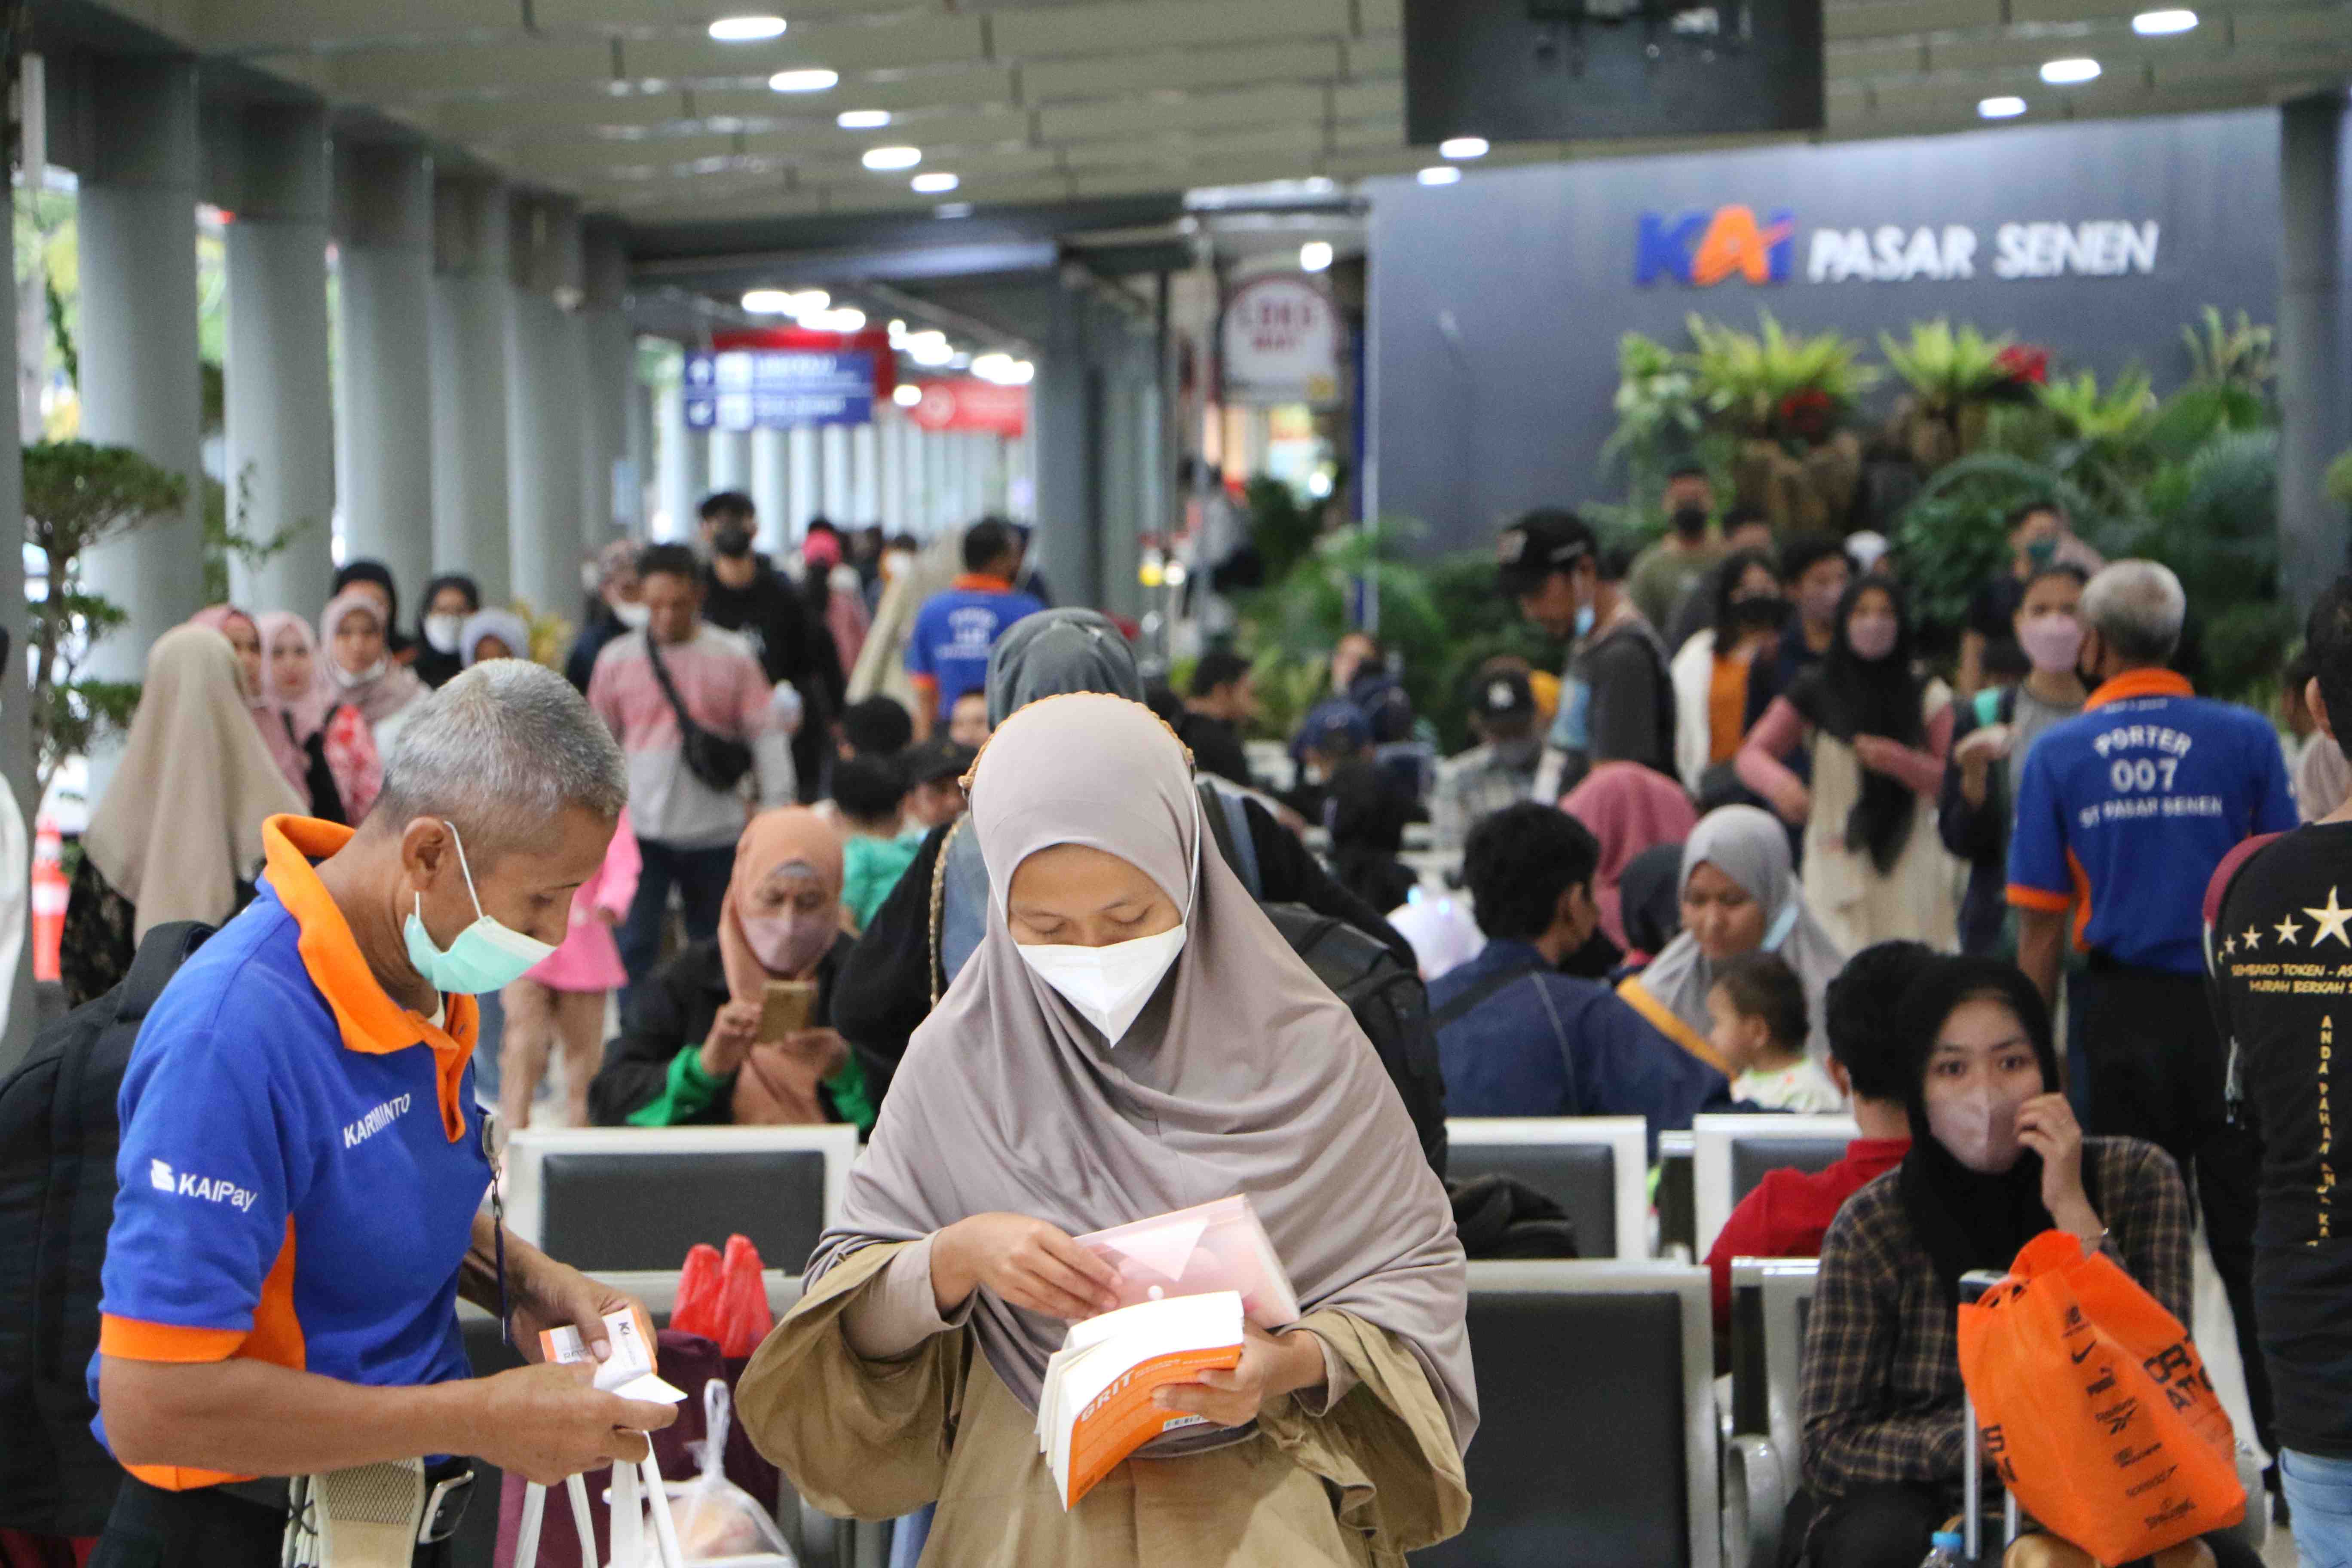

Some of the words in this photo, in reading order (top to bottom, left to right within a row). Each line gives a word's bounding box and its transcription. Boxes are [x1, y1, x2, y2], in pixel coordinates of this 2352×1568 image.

[1635, 205, 1793, 285] KAI
[1808, 226, 1976, 282] PASAR
[1994, 220, 2160, 279] SENEN
[2093, 724, 2192, 758] PORTER
[2110, 757, 2178, 792] 007
[2102, 797, 2159, 822] PASAR
[2161, 794, 2223, 818] SENEN
[2231, 964, 2280, 977] SEMBAKO
[2282, 963, 2326, 976] TOKEN
[2249, 980, 2290, 992] MURAH
[2293, 980, 2346, 994] BERKAH
[2319, 1014, 2333, 1075] ANDA
[343, 1093, 410, 1149] KARMINTO
[178, 1173, 258, 1213] KAIPay
[1081, 1370, 1135, 1422] GRIT
